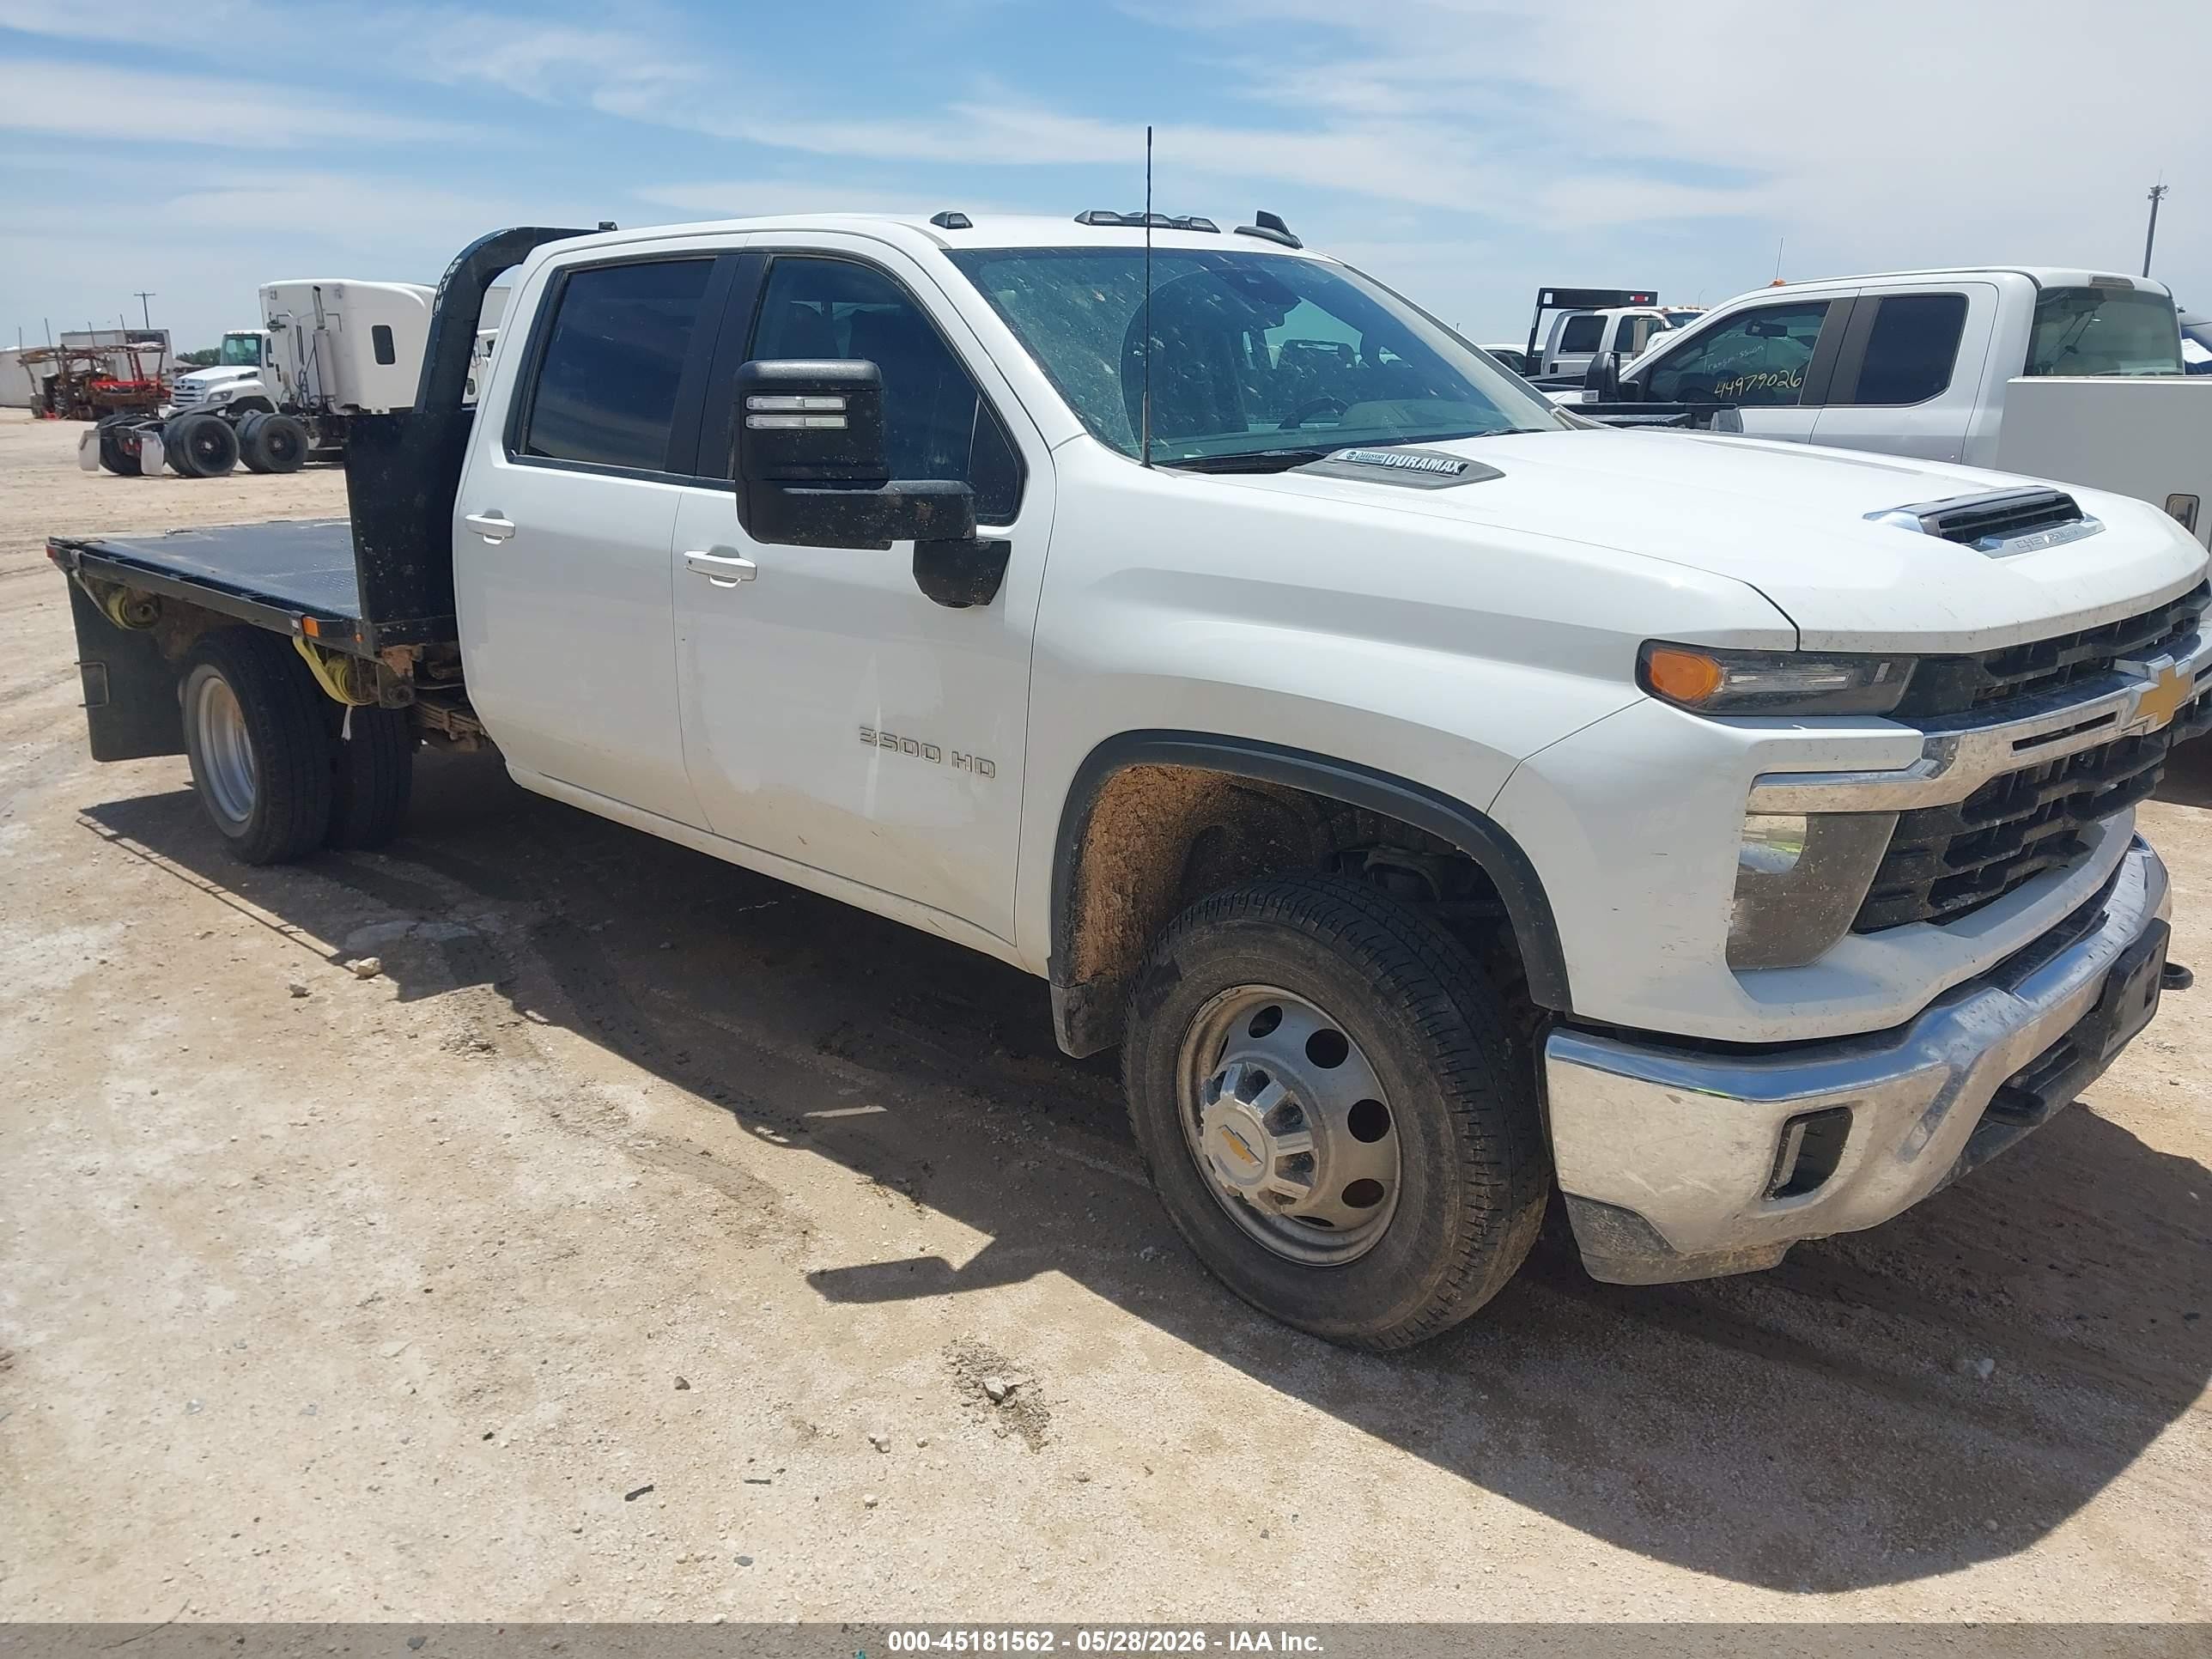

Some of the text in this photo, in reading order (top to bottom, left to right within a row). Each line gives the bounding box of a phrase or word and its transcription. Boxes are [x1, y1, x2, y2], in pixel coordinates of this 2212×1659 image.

[1698, 345, 1765, 374] Transmssion
[1714, 369, 1802, 398] 44979026
[1357, 452, 1385, 460] Allison
[1384, 453, 1468, 475] DURAMAX
[859, 726, 996, 779] 3500 HD
